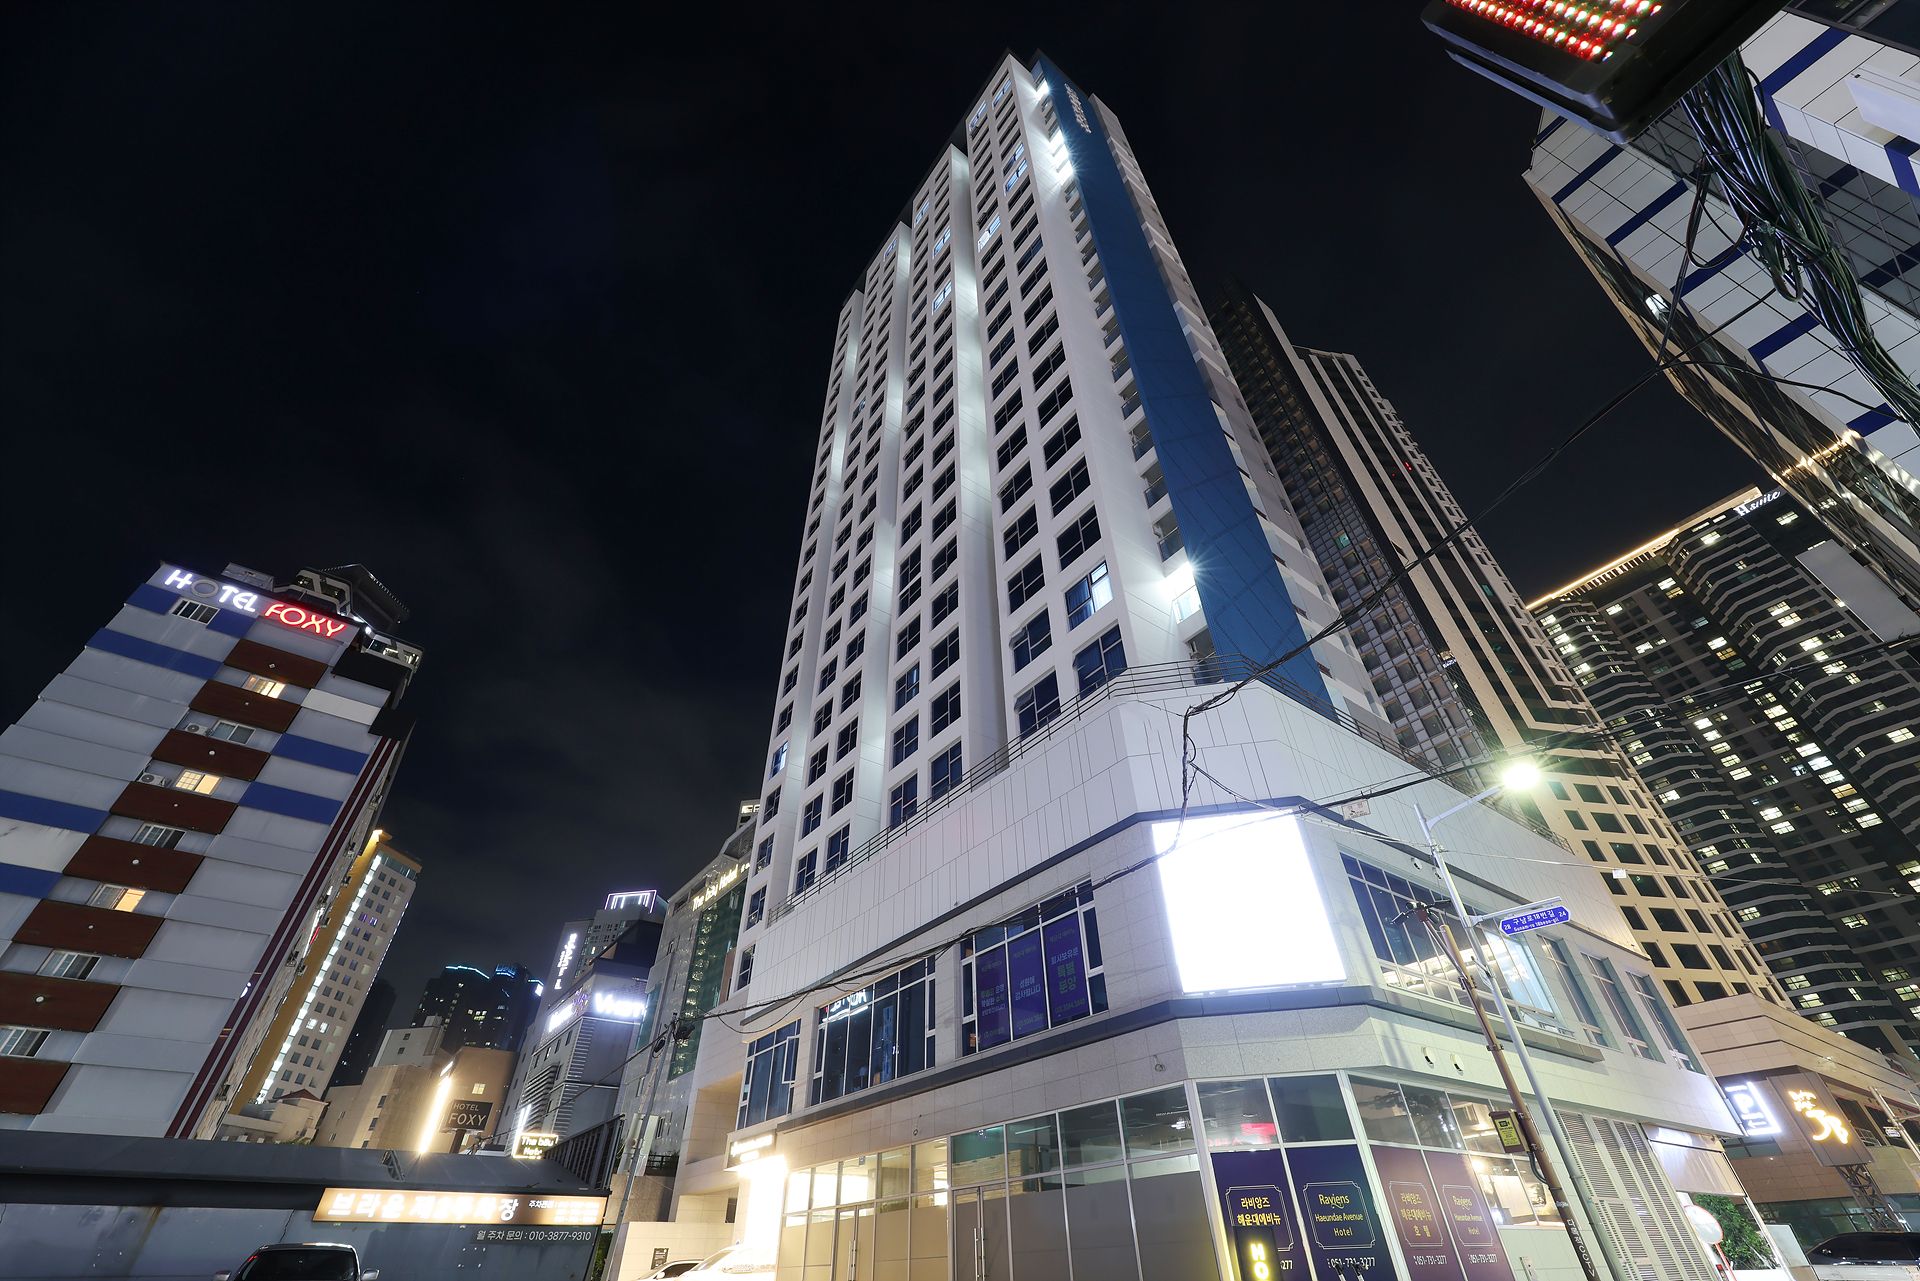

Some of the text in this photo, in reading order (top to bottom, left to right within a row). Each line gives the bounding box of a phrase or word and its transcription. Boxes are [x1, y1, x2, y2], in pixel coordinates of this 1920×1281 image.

[164, 569, 345, 637] HOTEL FOXY
[1558, 910, 1567, 918] 24
[453, 1103, 479, 1112] HOTEL
[448, 1113, 487, 1126] FOXY
[1240, 1196, 1271, 1210] 라비앙즈
[1318, 1193, 1350, 1207] Raviens
[1400, 1192, 1423, 1205] 라비앙즈
[1237, 1212, 1281, 1227] 해운대에비뉴
[1314, 1212, 1364, 1223] Haeundae Avenue
[1400, 1208, 1433, 1221] 해운대에비뉴
[476, 1230, 486, 1241] 월
[487, 1230, 505, 1241] 주차
[506, 1230, 524, 1241] 문의
[528, 1231, 592, 1241] 010-3877-9310
[1333, 1227, 1353, 1237] Hotel
